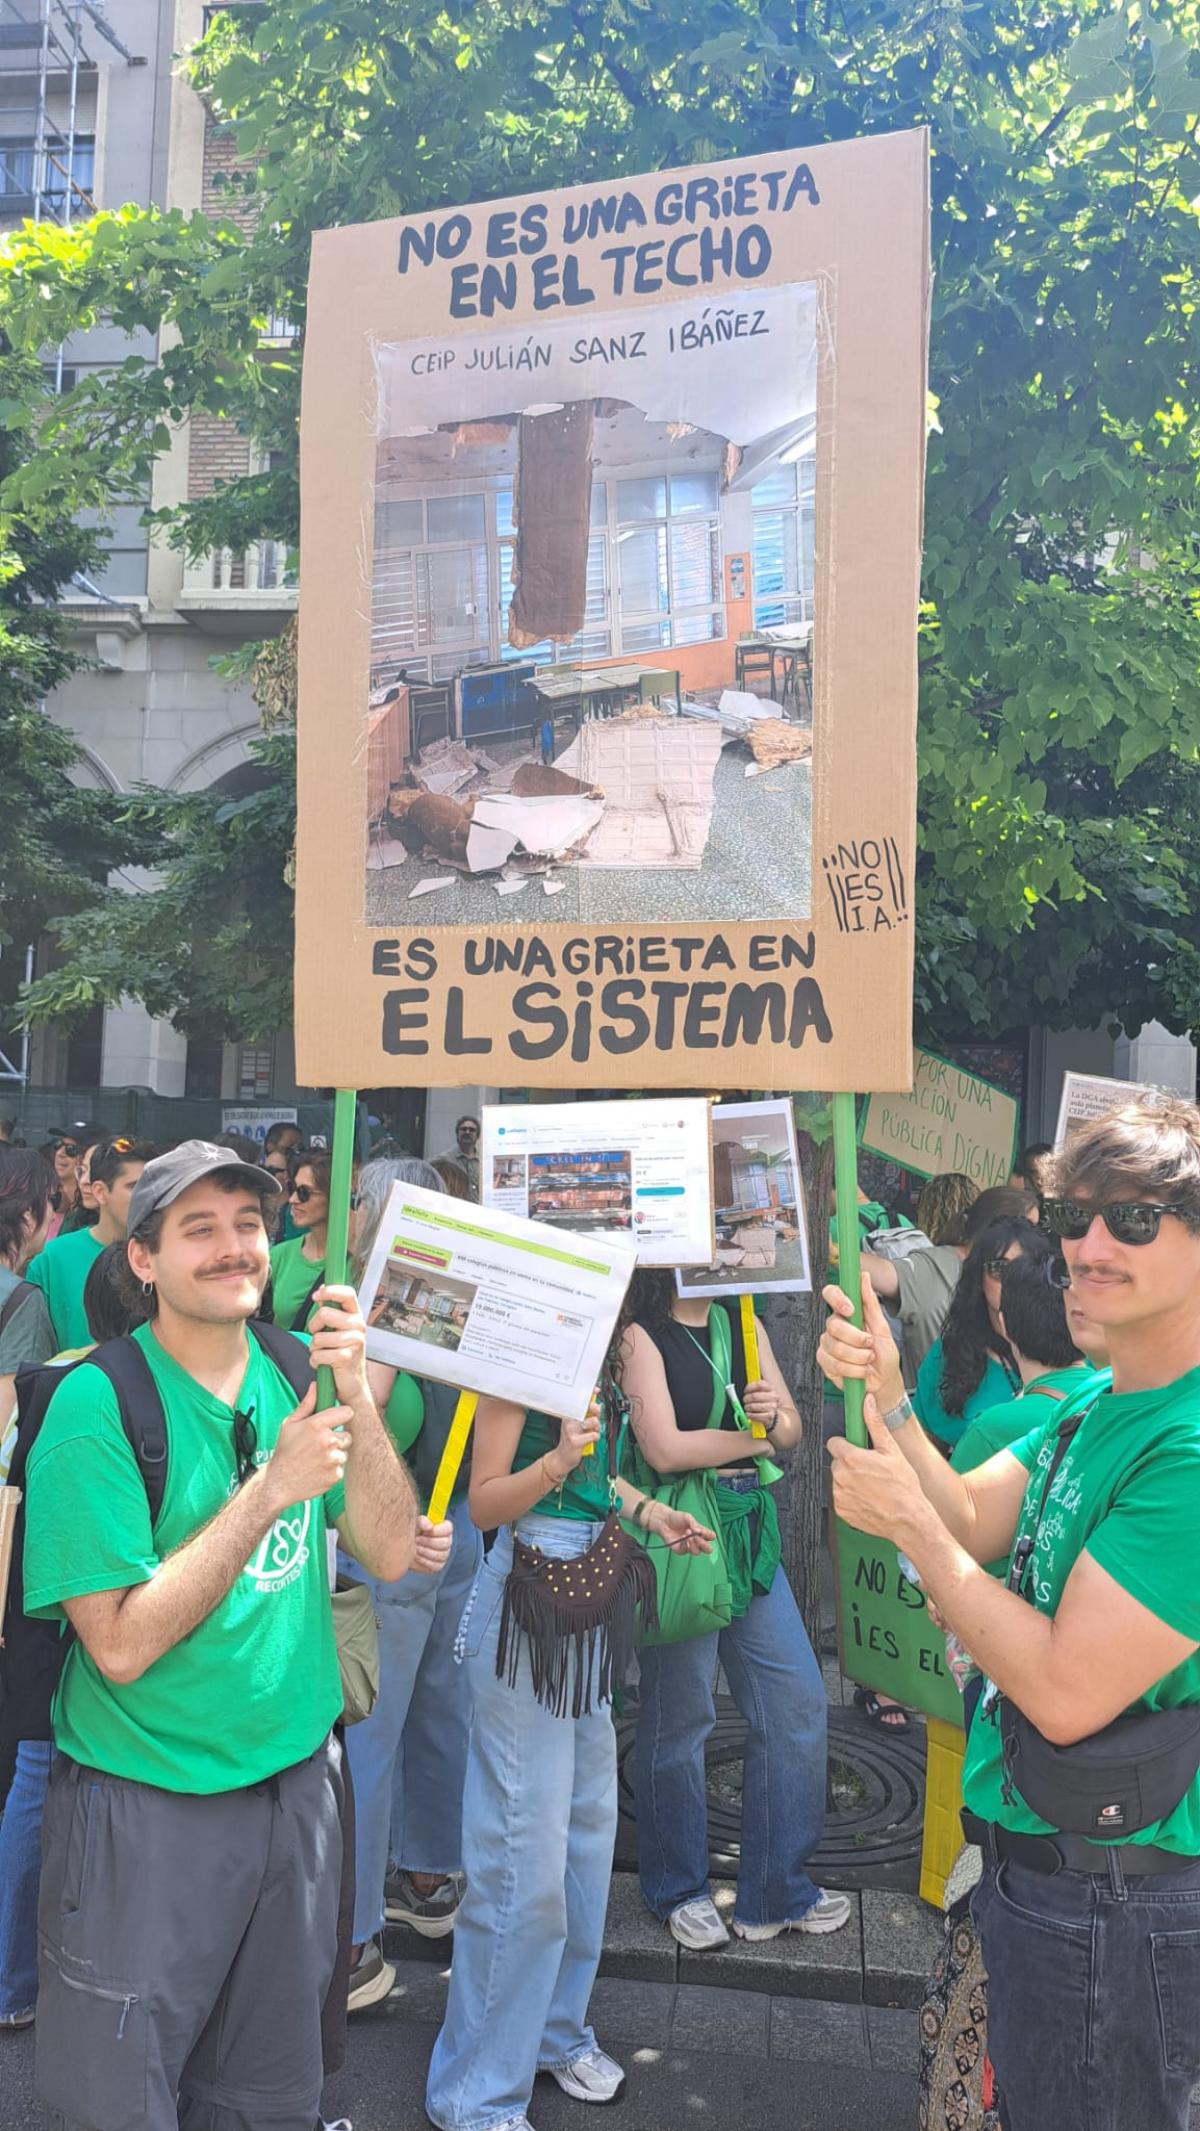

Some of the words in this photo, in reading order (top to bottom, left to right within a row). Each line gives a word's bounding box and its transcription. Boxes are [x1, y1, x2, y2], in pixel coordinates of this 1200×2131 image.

[398, 214, 472, 274] NO
[486, 204, 548, 259] ES
[563, 191, 647, 244] UNA
[449, 261, 517, 318] EN
[531, 254, 595, 311] EL
[601, 224, 772, 296] TECHO
[569, 331, 647, 365] SANZ
[668, 307, 770, 353] IBÁÑEZ
[372, 937, 438, 981] ES
[464, 936, 556, 977] UNA
[749, 930, 816, 971] EN
[382, 986, 493, 1056] EL
[916, 1053, 949, 1089] POR
[957, 1073, 992, 1112] UNA
[855, 1556, 886, 1594] NO
[919, 1648, 945, 1677] EL
